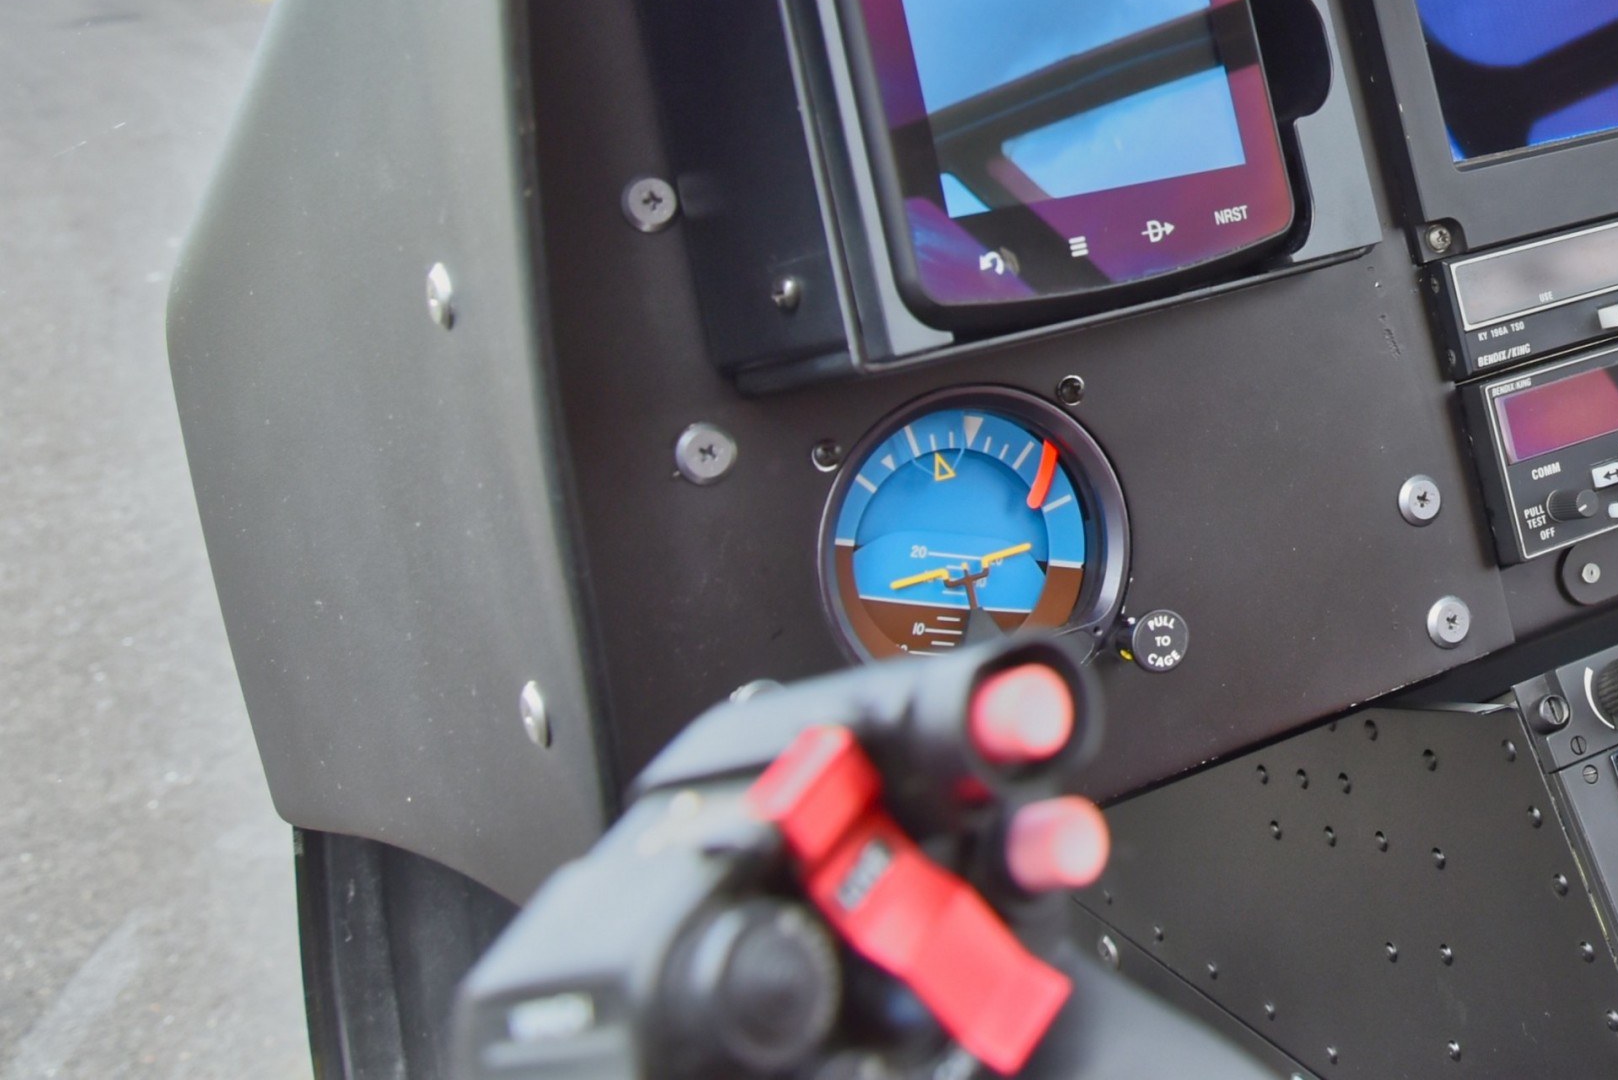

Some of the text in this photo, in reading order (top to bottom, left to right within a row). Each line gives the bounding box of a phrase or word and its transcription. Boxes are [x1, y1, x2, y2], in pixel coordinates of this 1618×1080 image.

[1214, 205, 1248, 226] NRST
[1477, 332, 1488, 342] KY
[1491, 326, 1508, 338] 196A
[1477, 342, 1532, 367] BENDIX/KING
[1531, 462, 1561, 481] COMM
[1524, 505, 1545, 519] PULL
[1527, 516, 1547, 530] TEST
[1540, 527, 1556, 541] OFF
[910, 545, 928, 559] 20
[912, 622, 925, 636] 10
[1147, 616, 1175, 631] PULL
[1154, 635, 1172, 647] TO
[1147, 648, 1182, 668] CAGE
